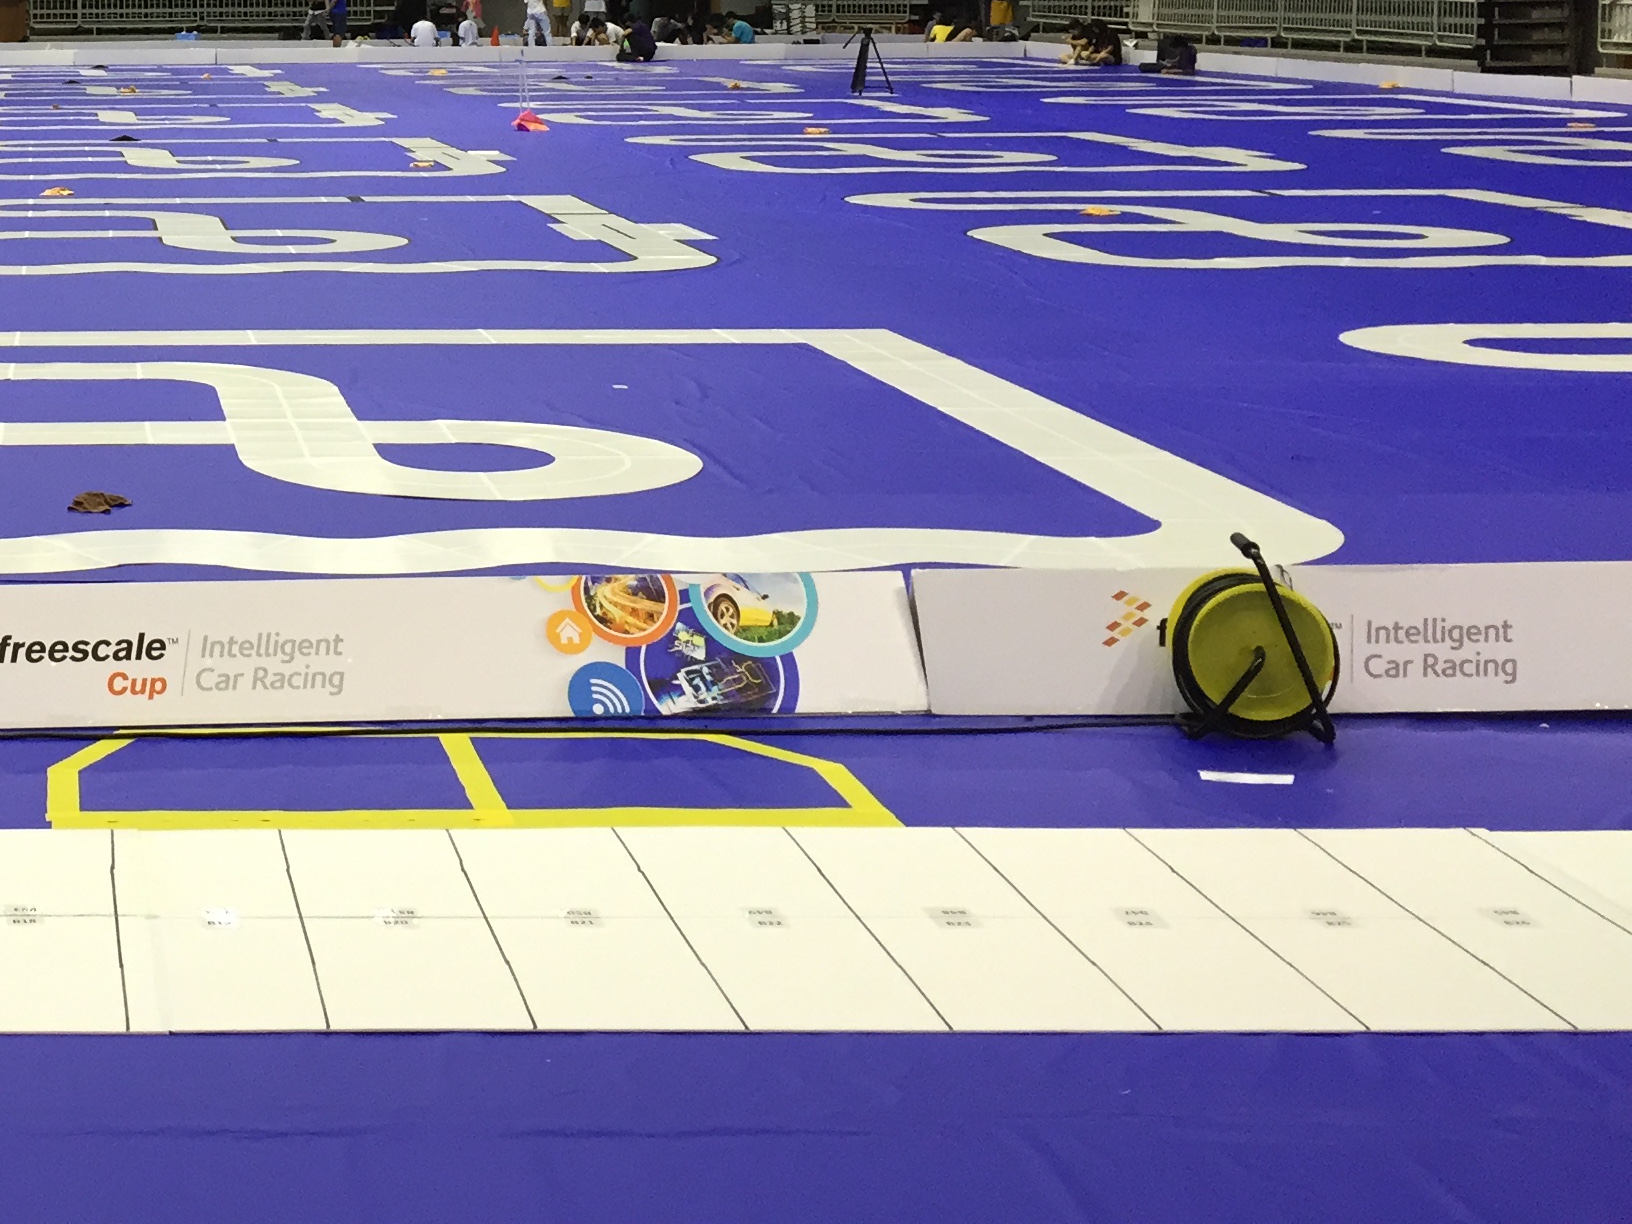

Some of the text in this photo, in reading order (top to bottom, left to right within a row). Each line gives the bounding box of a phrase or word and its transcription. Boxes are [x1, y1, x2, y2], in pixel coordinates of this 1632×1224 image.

[200, 632, 345, 664] Intelligent
[1365, 618, 1514, 650] Intelligent
[194, 666, 346, 696] Car Racing
[1363, 653, 1519, 684] Car Racing
[106, 671, 168, 701] Cup
